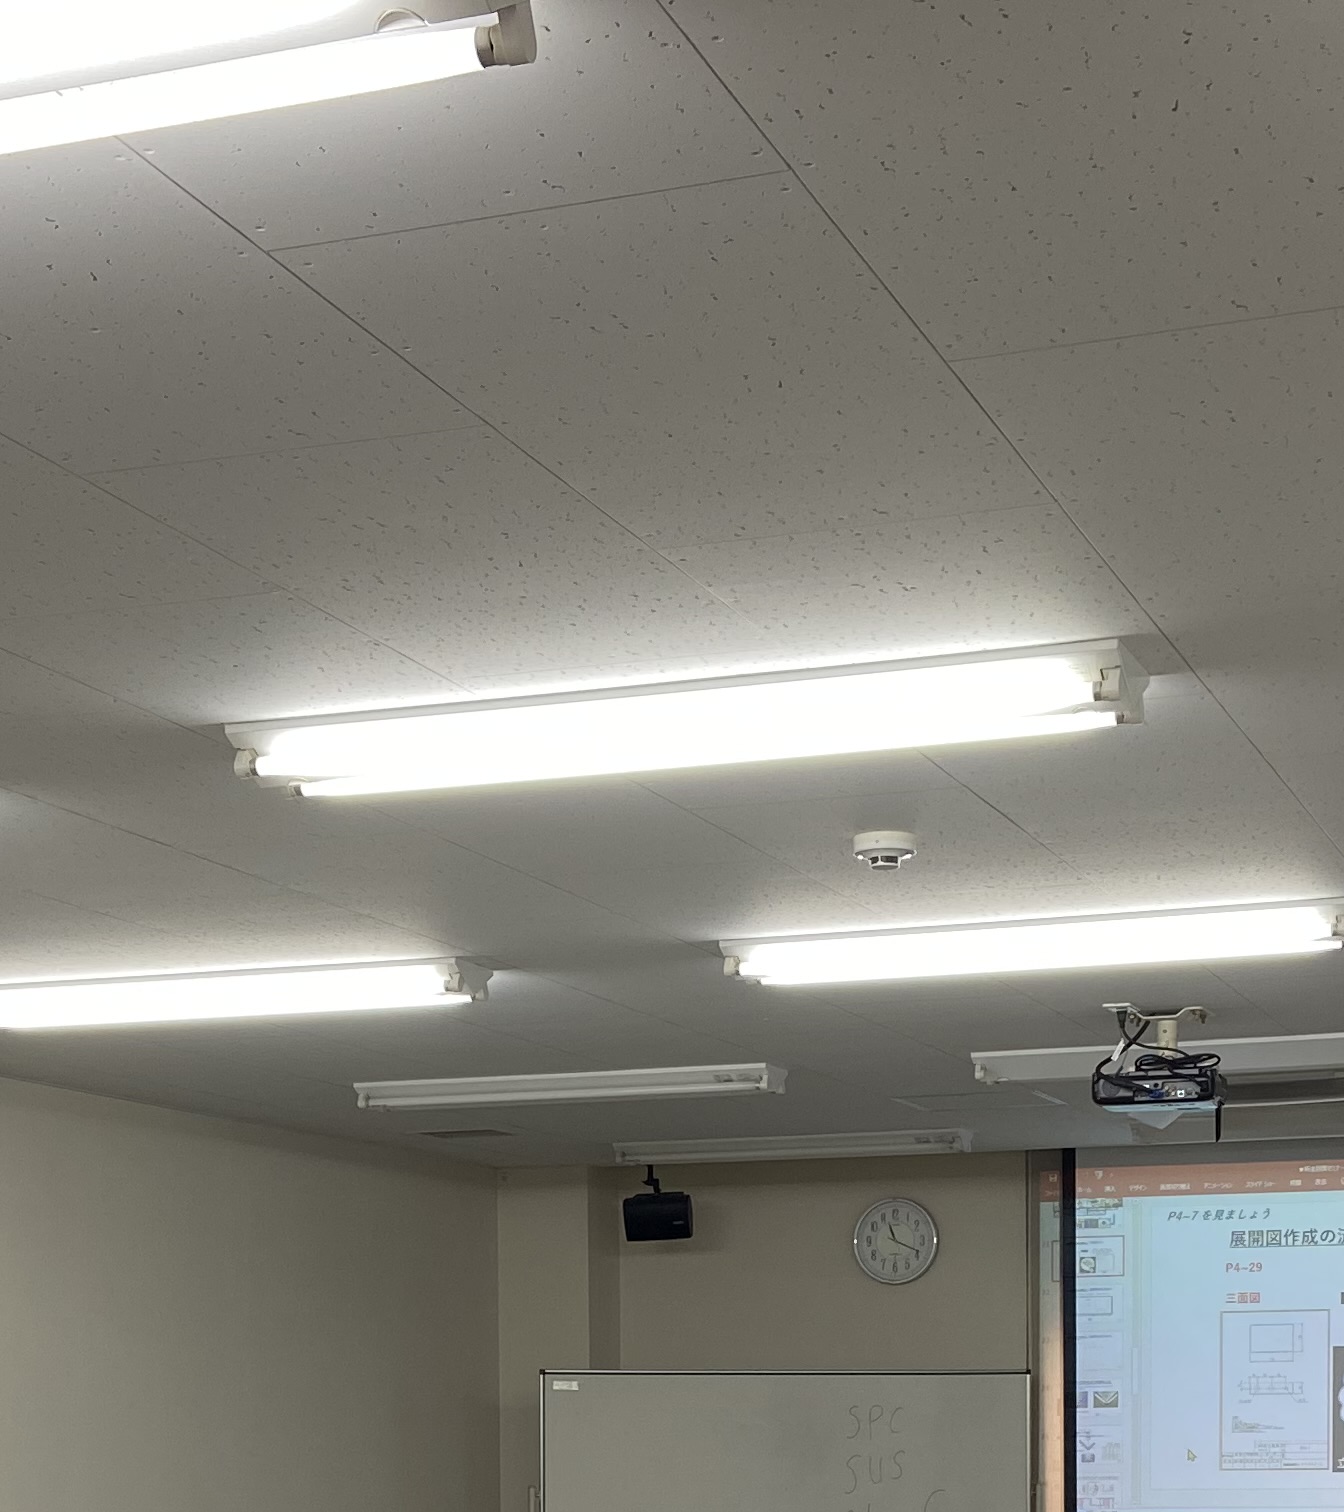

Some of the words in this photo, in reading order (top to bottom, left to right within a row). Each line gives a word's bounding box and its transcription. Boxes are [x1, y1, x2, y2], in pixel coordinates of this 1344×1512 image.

[1202, 1207, 1271, 1221] を見ましょう
[1225, 1291, 1261, 1304] 三面図
[846, 1404, 904, 1440] SPC
[844, 1450, 906, 1495] SUS
